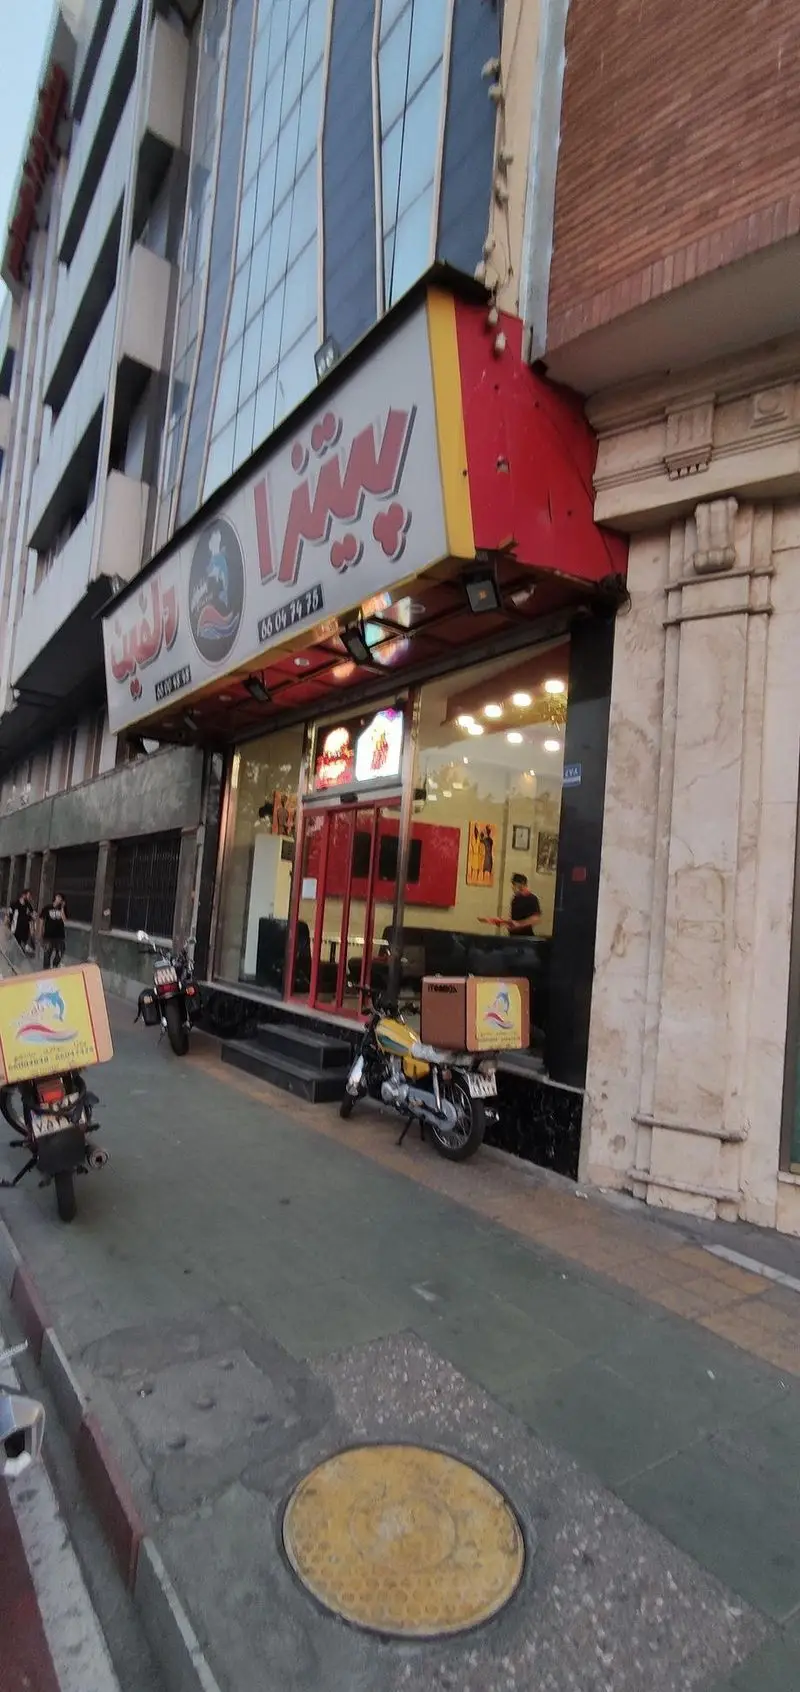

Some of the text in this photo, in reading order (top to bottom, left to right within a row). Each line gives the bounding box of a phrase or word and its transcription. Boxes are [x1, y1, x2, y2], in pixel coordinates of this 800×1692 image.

[111, 407, 416, 701] پیتزا دلفین
[261, 619, 273, 640] 66
